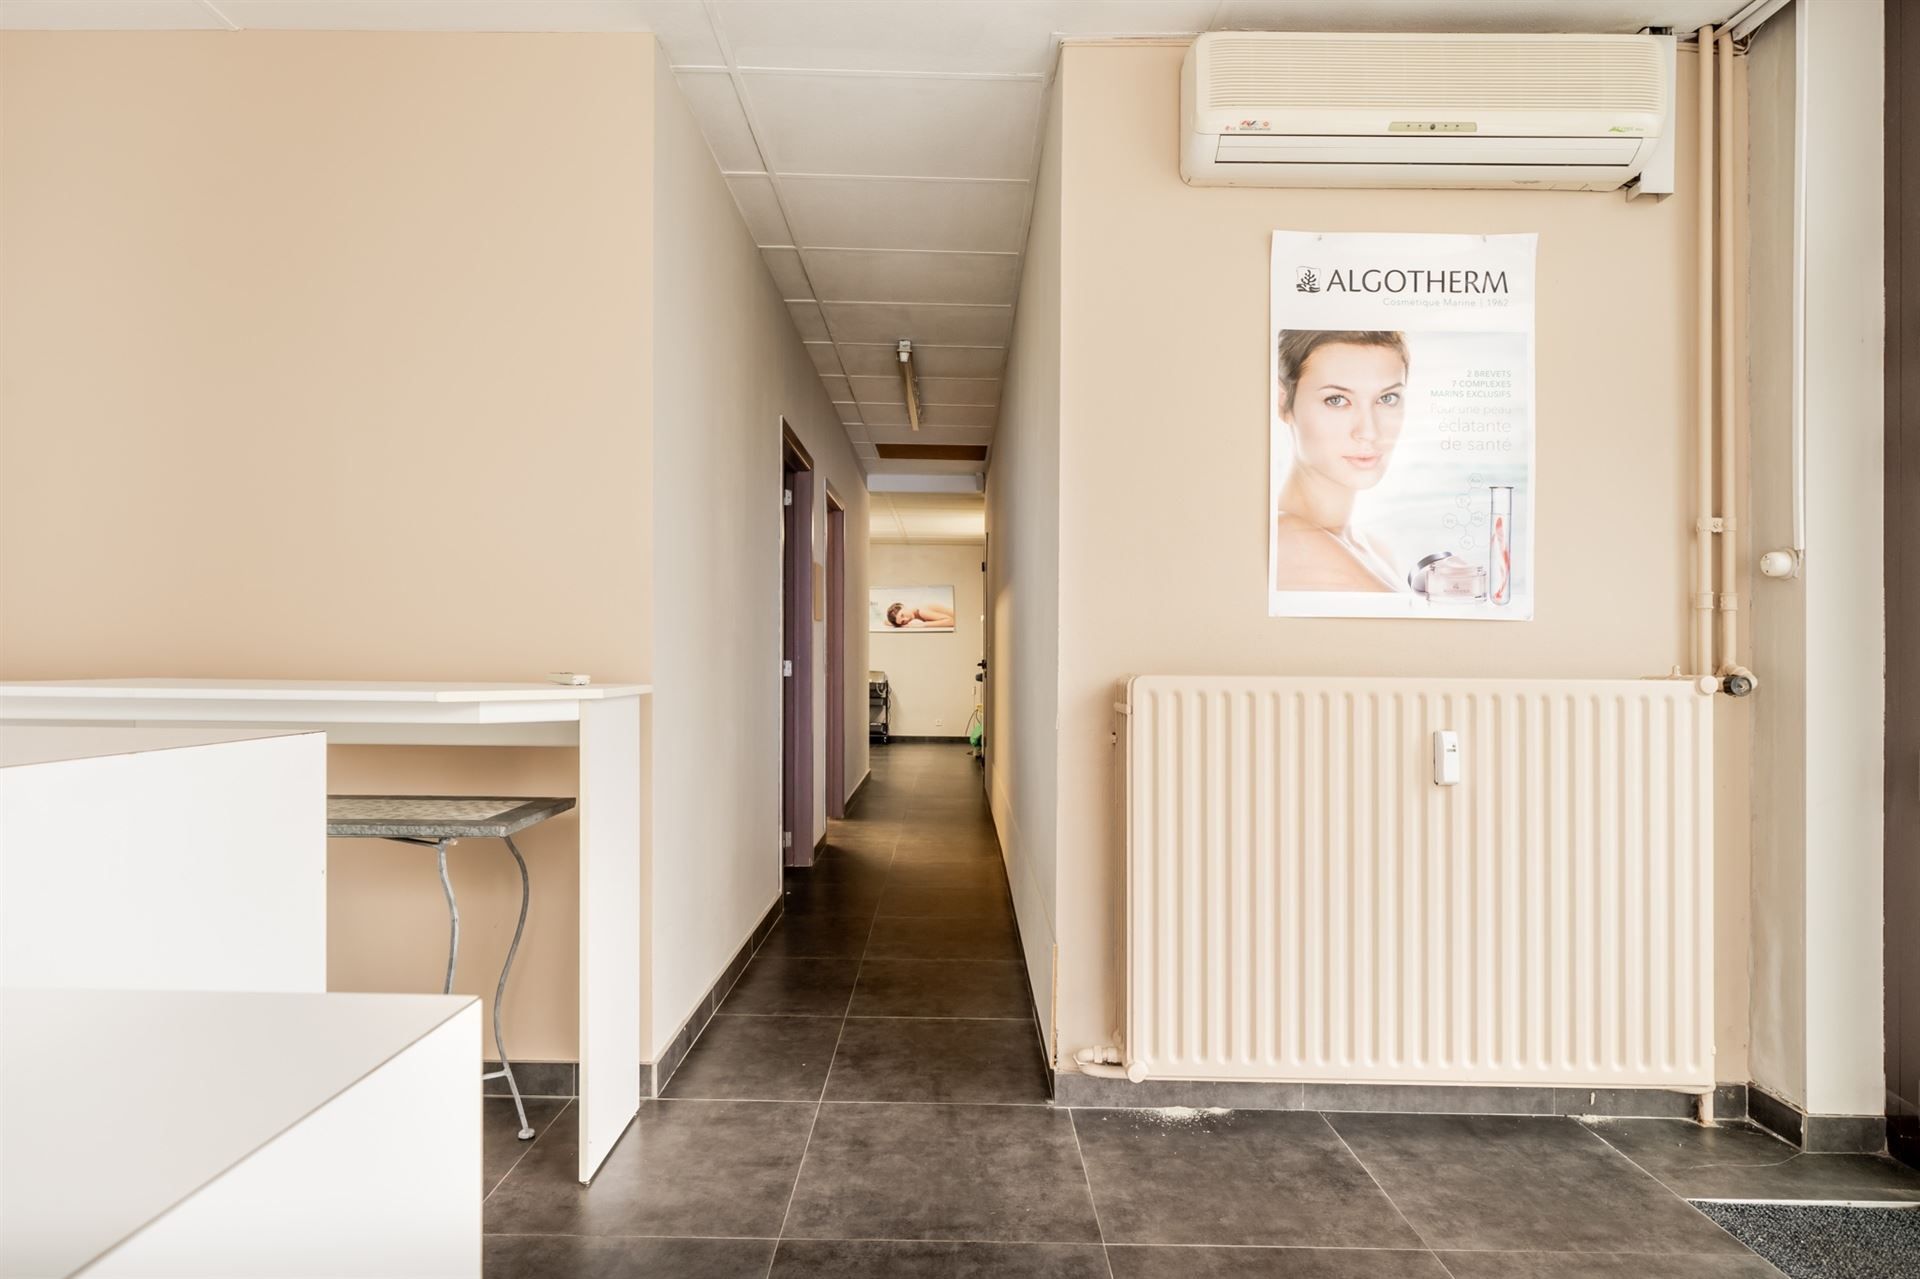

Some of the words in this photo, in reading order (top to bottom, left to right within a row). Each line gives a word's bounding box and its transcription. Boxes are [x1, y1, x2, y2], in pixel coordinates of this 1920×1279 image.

[1327, 268, 1509, 294] ALGOTHERM
[1443, 297, 1477, 307] Marine
[1474, 369, 1512, 378] BREVETS
[1459, 379, 1512, 389] COMPLEXES
[1430, 390, 1464, 398] MARINS
[1466, 390, 1512, 399] EXCLUSIFS
[1483, 406, 1512, 417] peau
[1438, 416, 1512, 433] éclatante
[1440, 435, 1461, 451] de
[1467, 437, 1512, 452] santé
